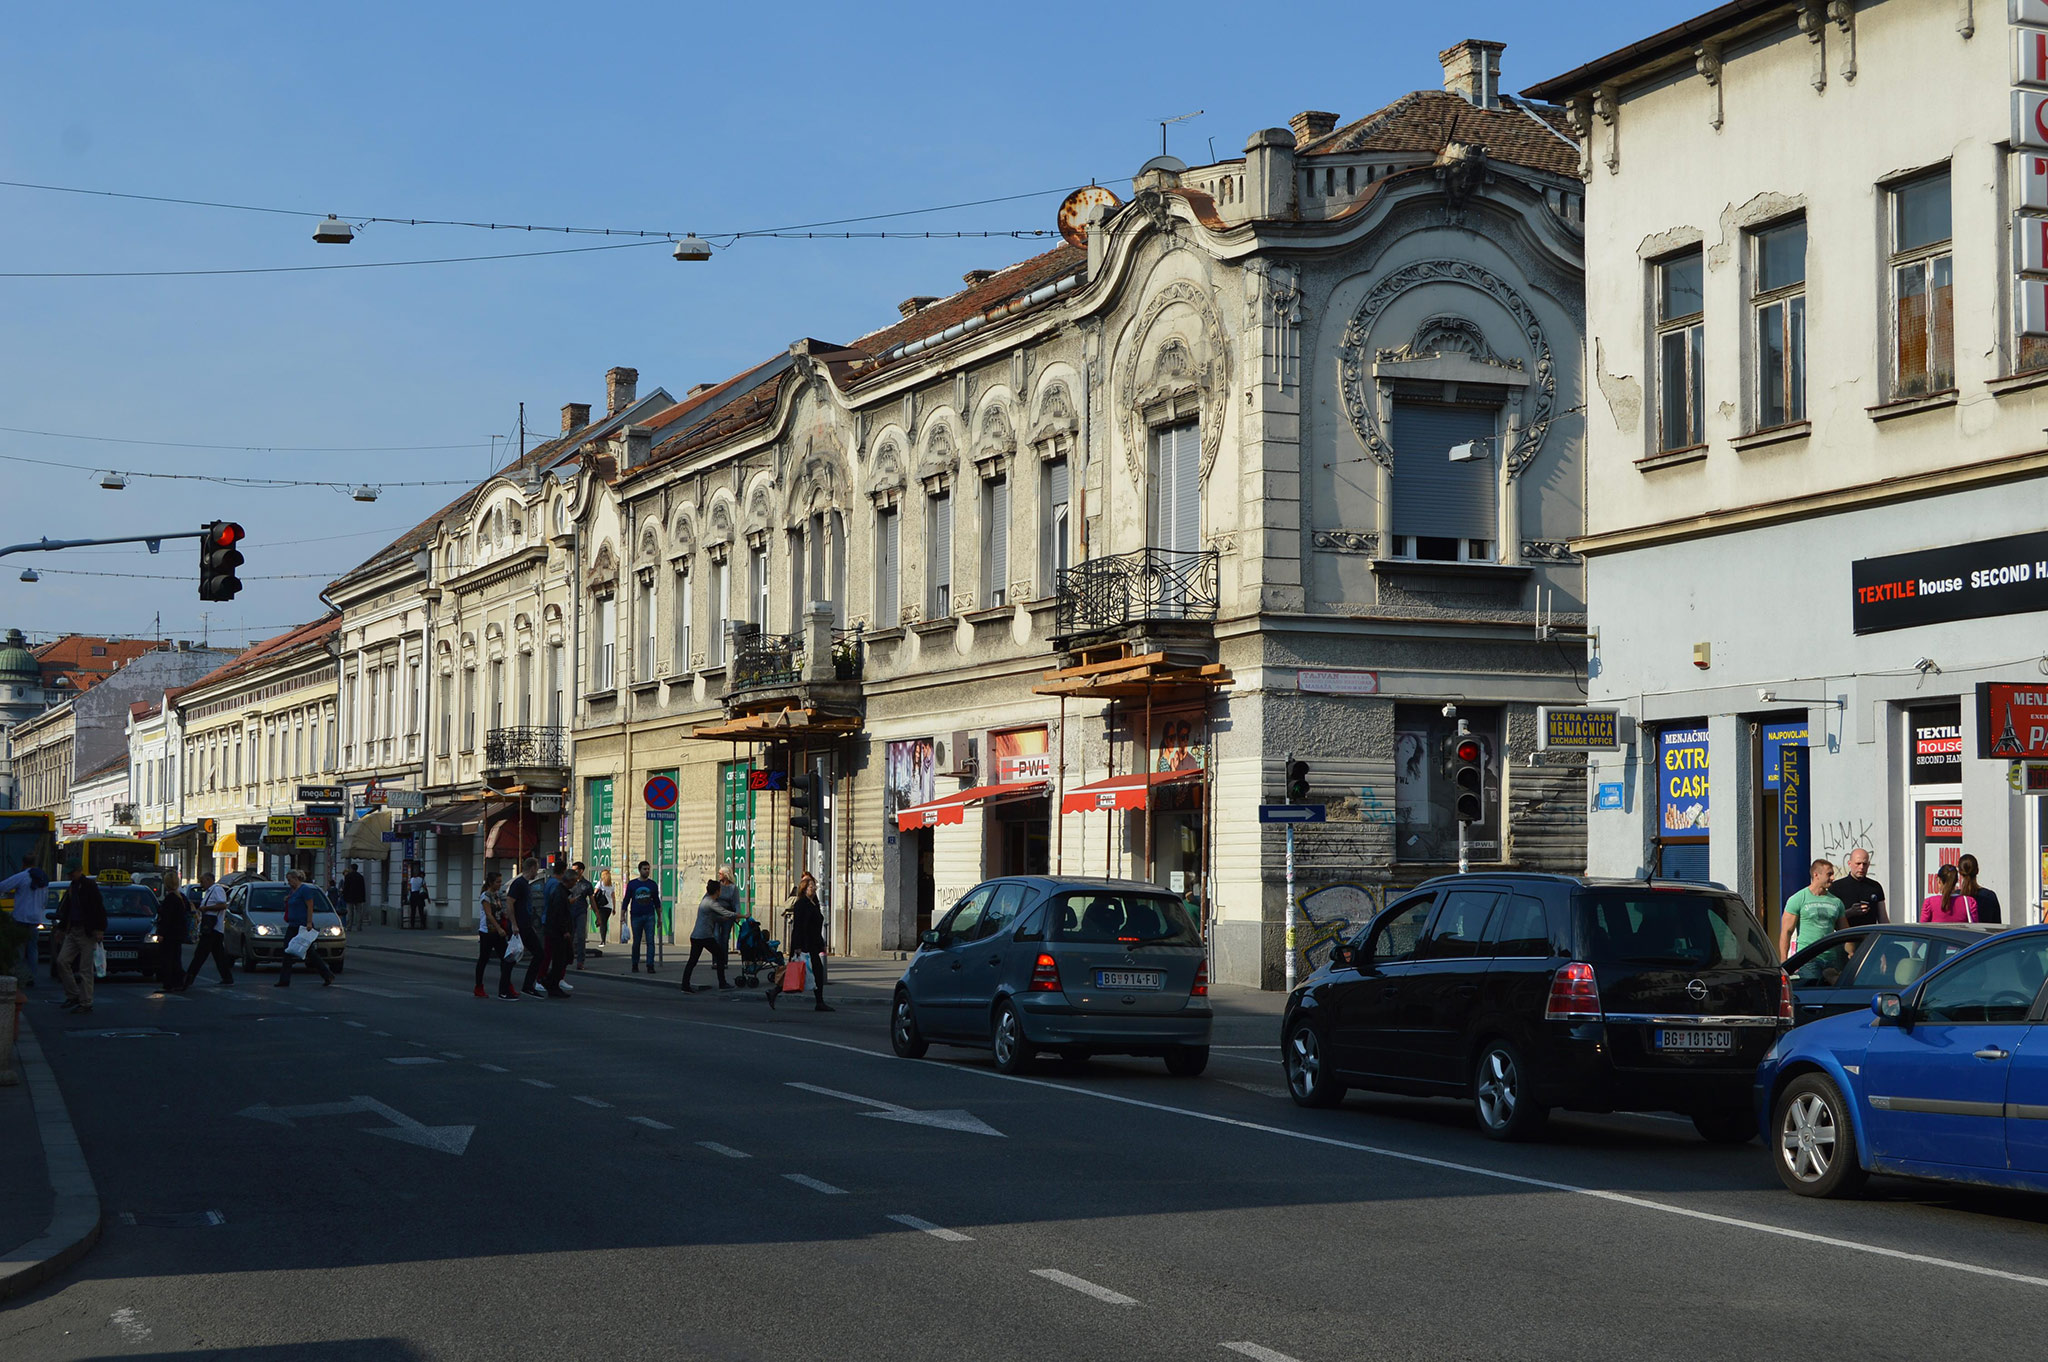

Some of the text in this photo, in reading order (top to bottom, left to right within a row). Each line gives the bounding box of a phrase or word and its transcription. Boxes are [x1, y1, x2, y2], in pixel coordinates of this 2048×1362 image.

[1858, 580, 1915, 604] TEXTILE
[1919, 579, 1962, 595] house
[1971, 563, 2030, 588] SECOND
[1550, 719, 1613, 736] MENJAČNICA
[1917, 755, 1945, 765] SECOND
[1019, 760, 1049, 777] PWL
[1104, 973, 1117, 984] BG
[1664, 1031, 1678, 1046] BG
